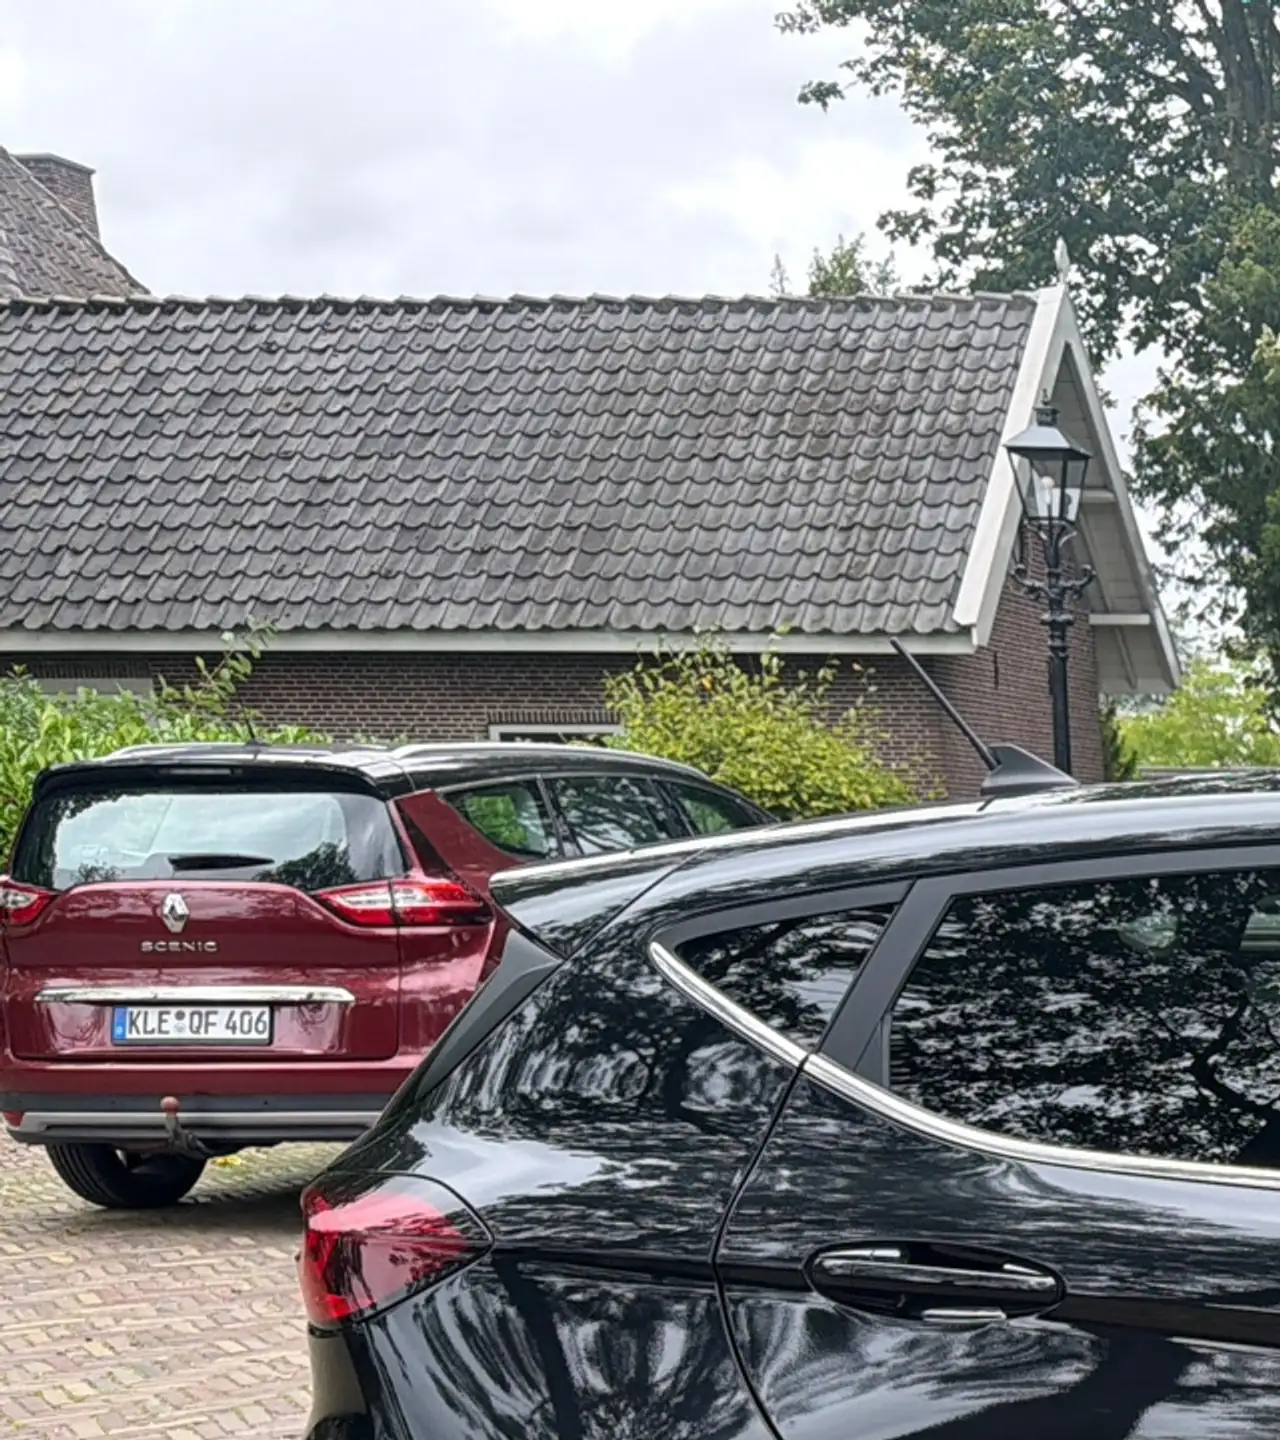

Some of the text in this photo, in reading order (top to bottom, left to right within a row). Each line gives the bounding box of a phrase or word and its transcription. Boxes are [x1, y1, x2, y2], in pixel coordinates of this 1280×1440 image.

[141, 940, 218, 952] SCENIC
[128, 1010, 171, 1035] KLE
[225, 1010, 267, 1035] 406
